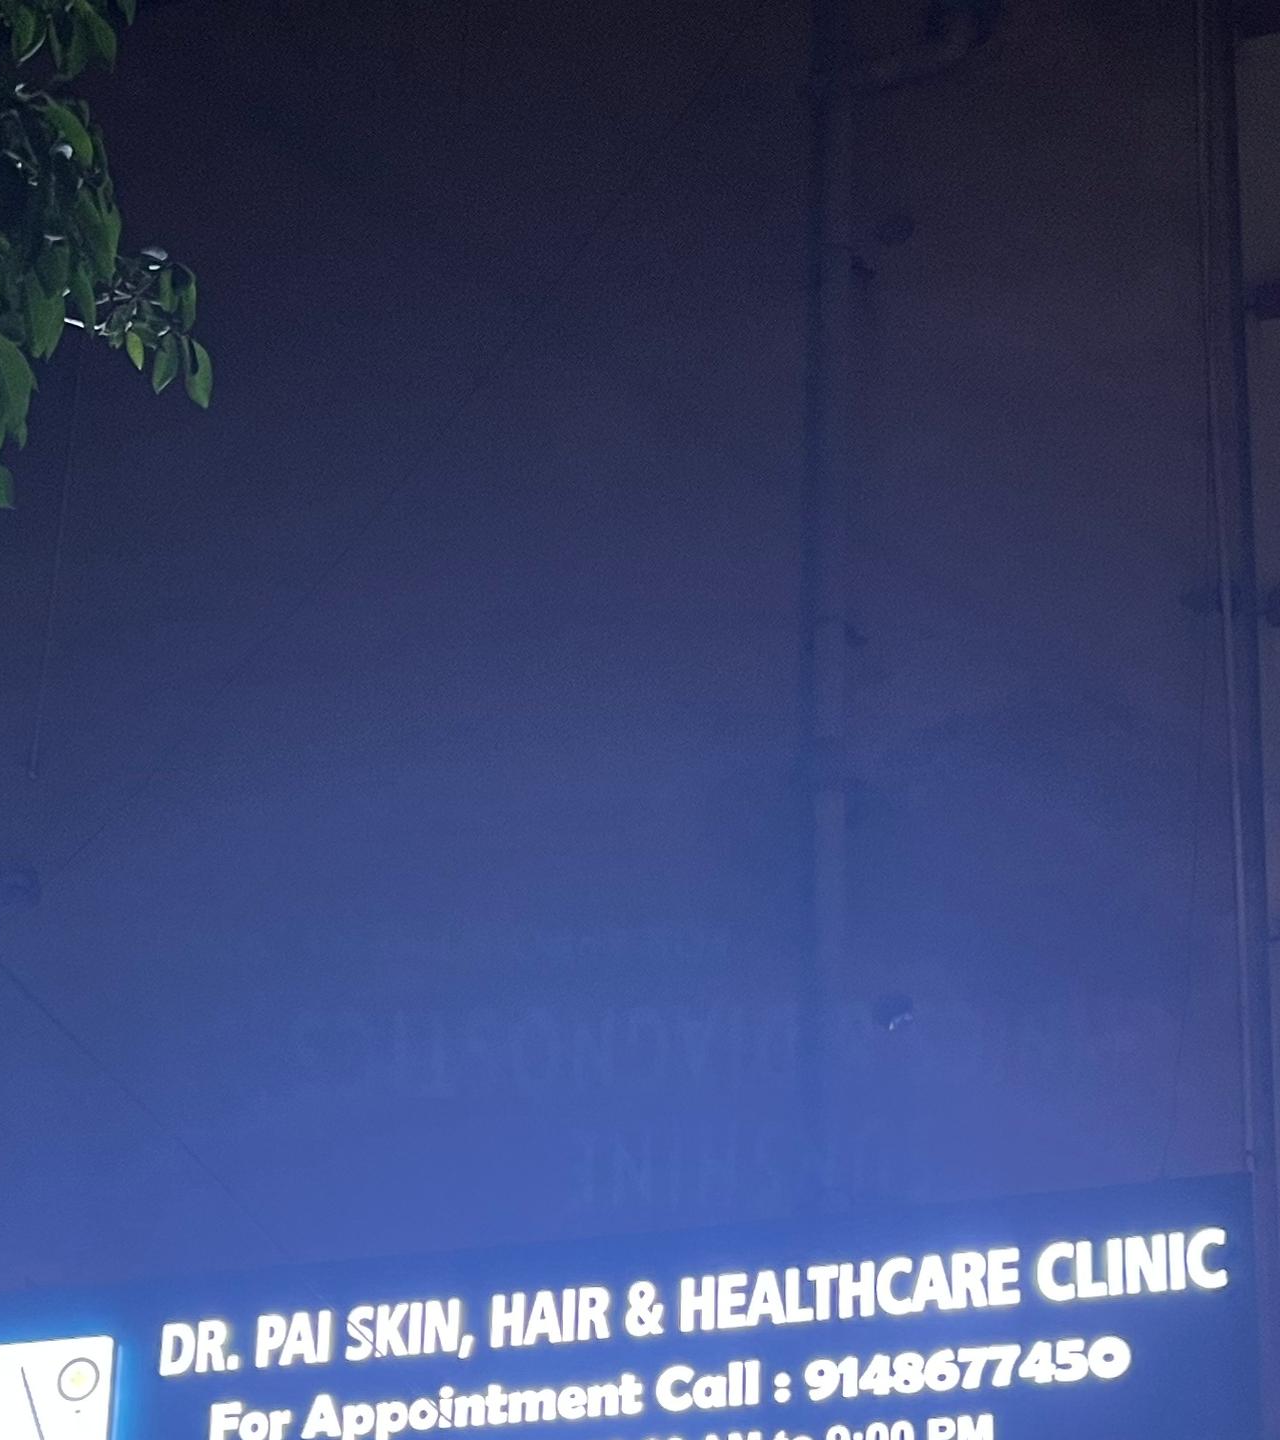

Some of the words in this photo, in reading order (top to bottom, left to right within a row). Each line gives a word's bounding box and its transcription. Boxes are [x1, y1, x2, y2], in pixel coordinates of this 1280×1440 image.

[158, 1318, 240, 1376] DR.
[254, 1309, 332, 1368] PAI
[345, 1298, 474, 1361] SKIN,
[490, 1285, 611, 1349] HAIR
[624, 1280, 665, 1337] &
[679, 1247, 1021, 1332] HEALTHCARE
[1037, 1227, 1229, 1302] CLINIC
[655, 1359, 762, 1411] Call
[805, 1336, 1132, 1402] 9148677450
